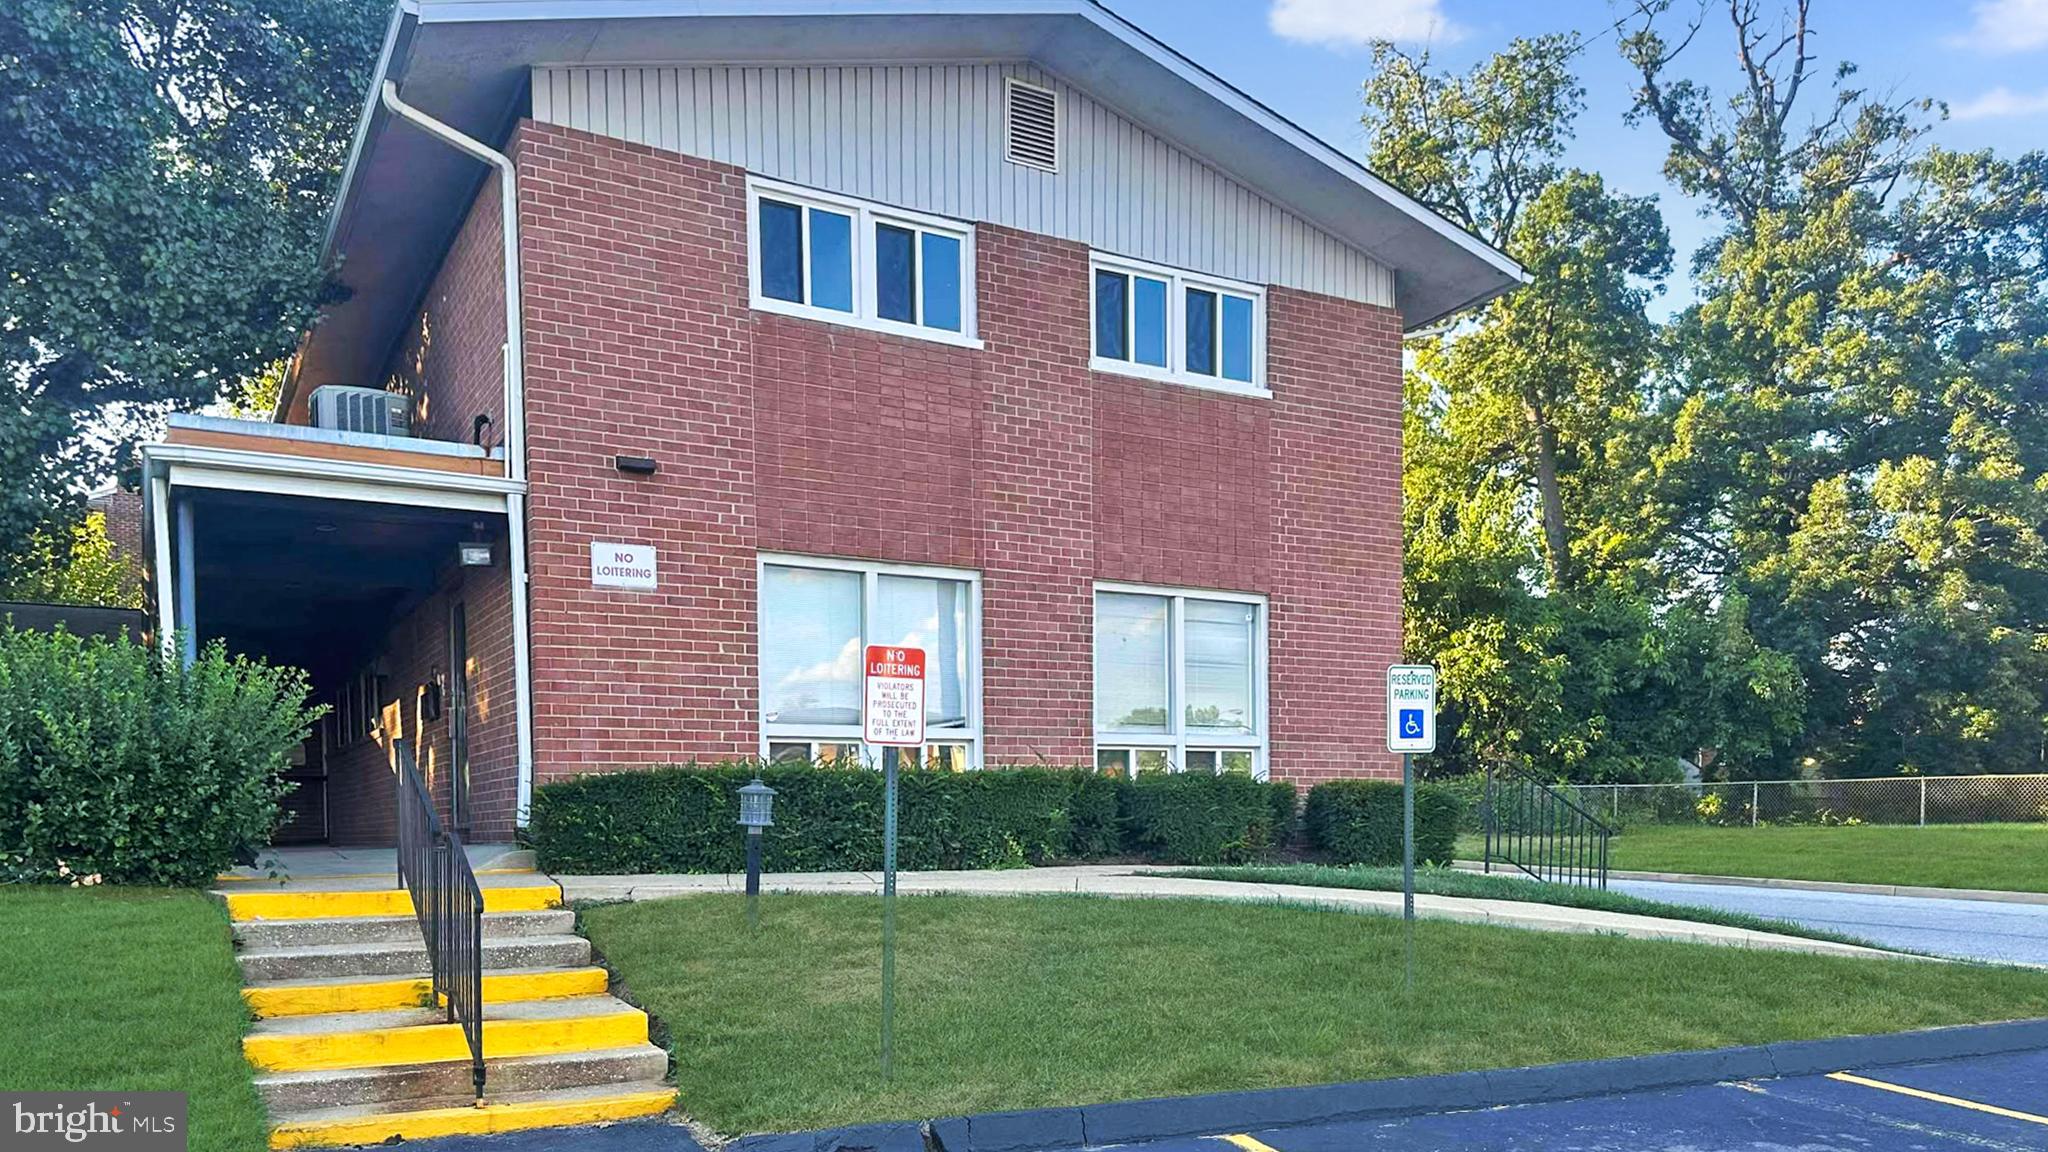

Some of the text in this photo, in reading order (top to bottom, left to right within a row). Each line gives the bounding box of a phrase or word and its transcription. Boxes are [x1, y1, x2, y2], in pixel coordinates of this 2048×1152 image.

[615, 552, 634, 563] NO
[597, 566, 651, 578] LOITERING
[886, 650, 905, 662] NO
[870, 662, 920, 676] LOITERING
[1392, 674, 1432, 685] RESERVED
[877, 682, 914, 691] VIOLATORS
[1394, 689, 1429, 700] PARKING
[873, 700, 917, 710] PROSECUTED
[894, 710, 907, 718] THE
[872, 718, 916, 728] FULL EXTENT
